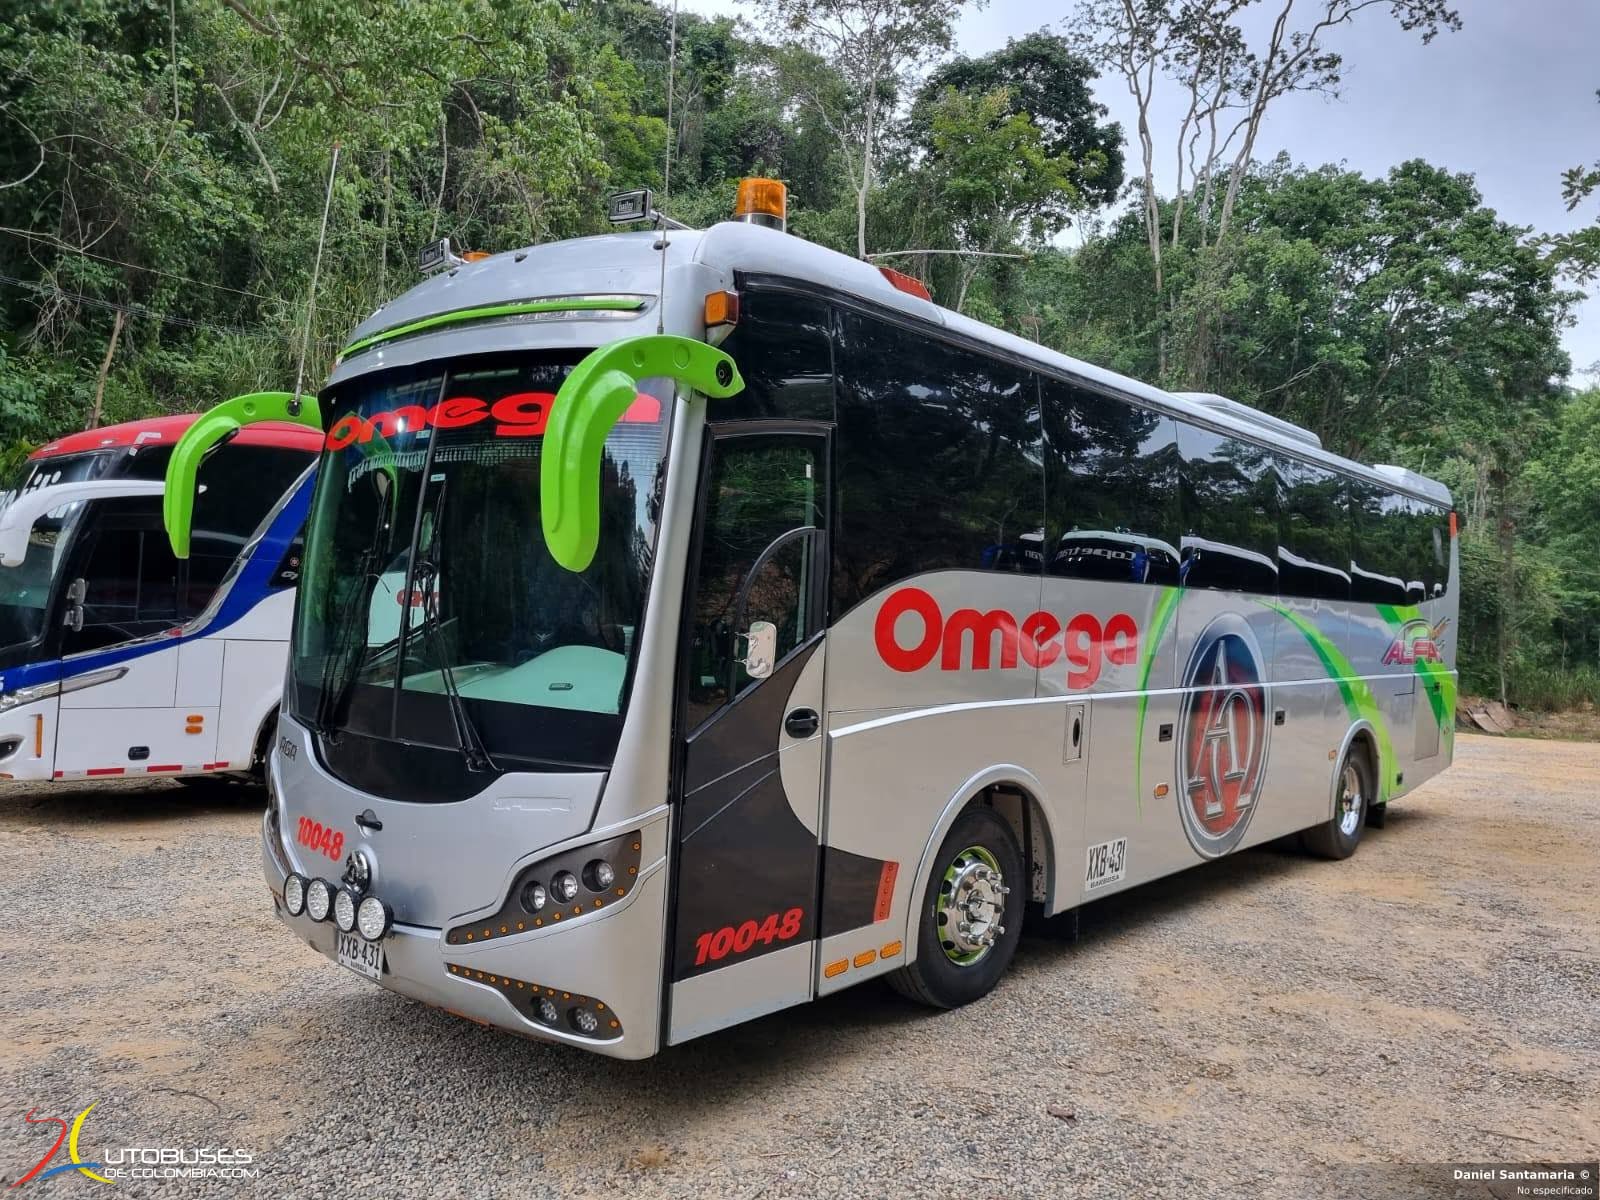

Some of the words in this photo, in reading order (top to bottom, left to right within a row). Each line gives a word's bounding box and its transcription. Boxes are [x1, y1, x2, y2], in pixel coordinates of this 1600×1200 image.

[874, 587, 1138, 689] Omega
[1382, 639, 1442, 666] ALFA
[297, 816, 344, 861] 10048
[694, 906, 804, 966] 10048
